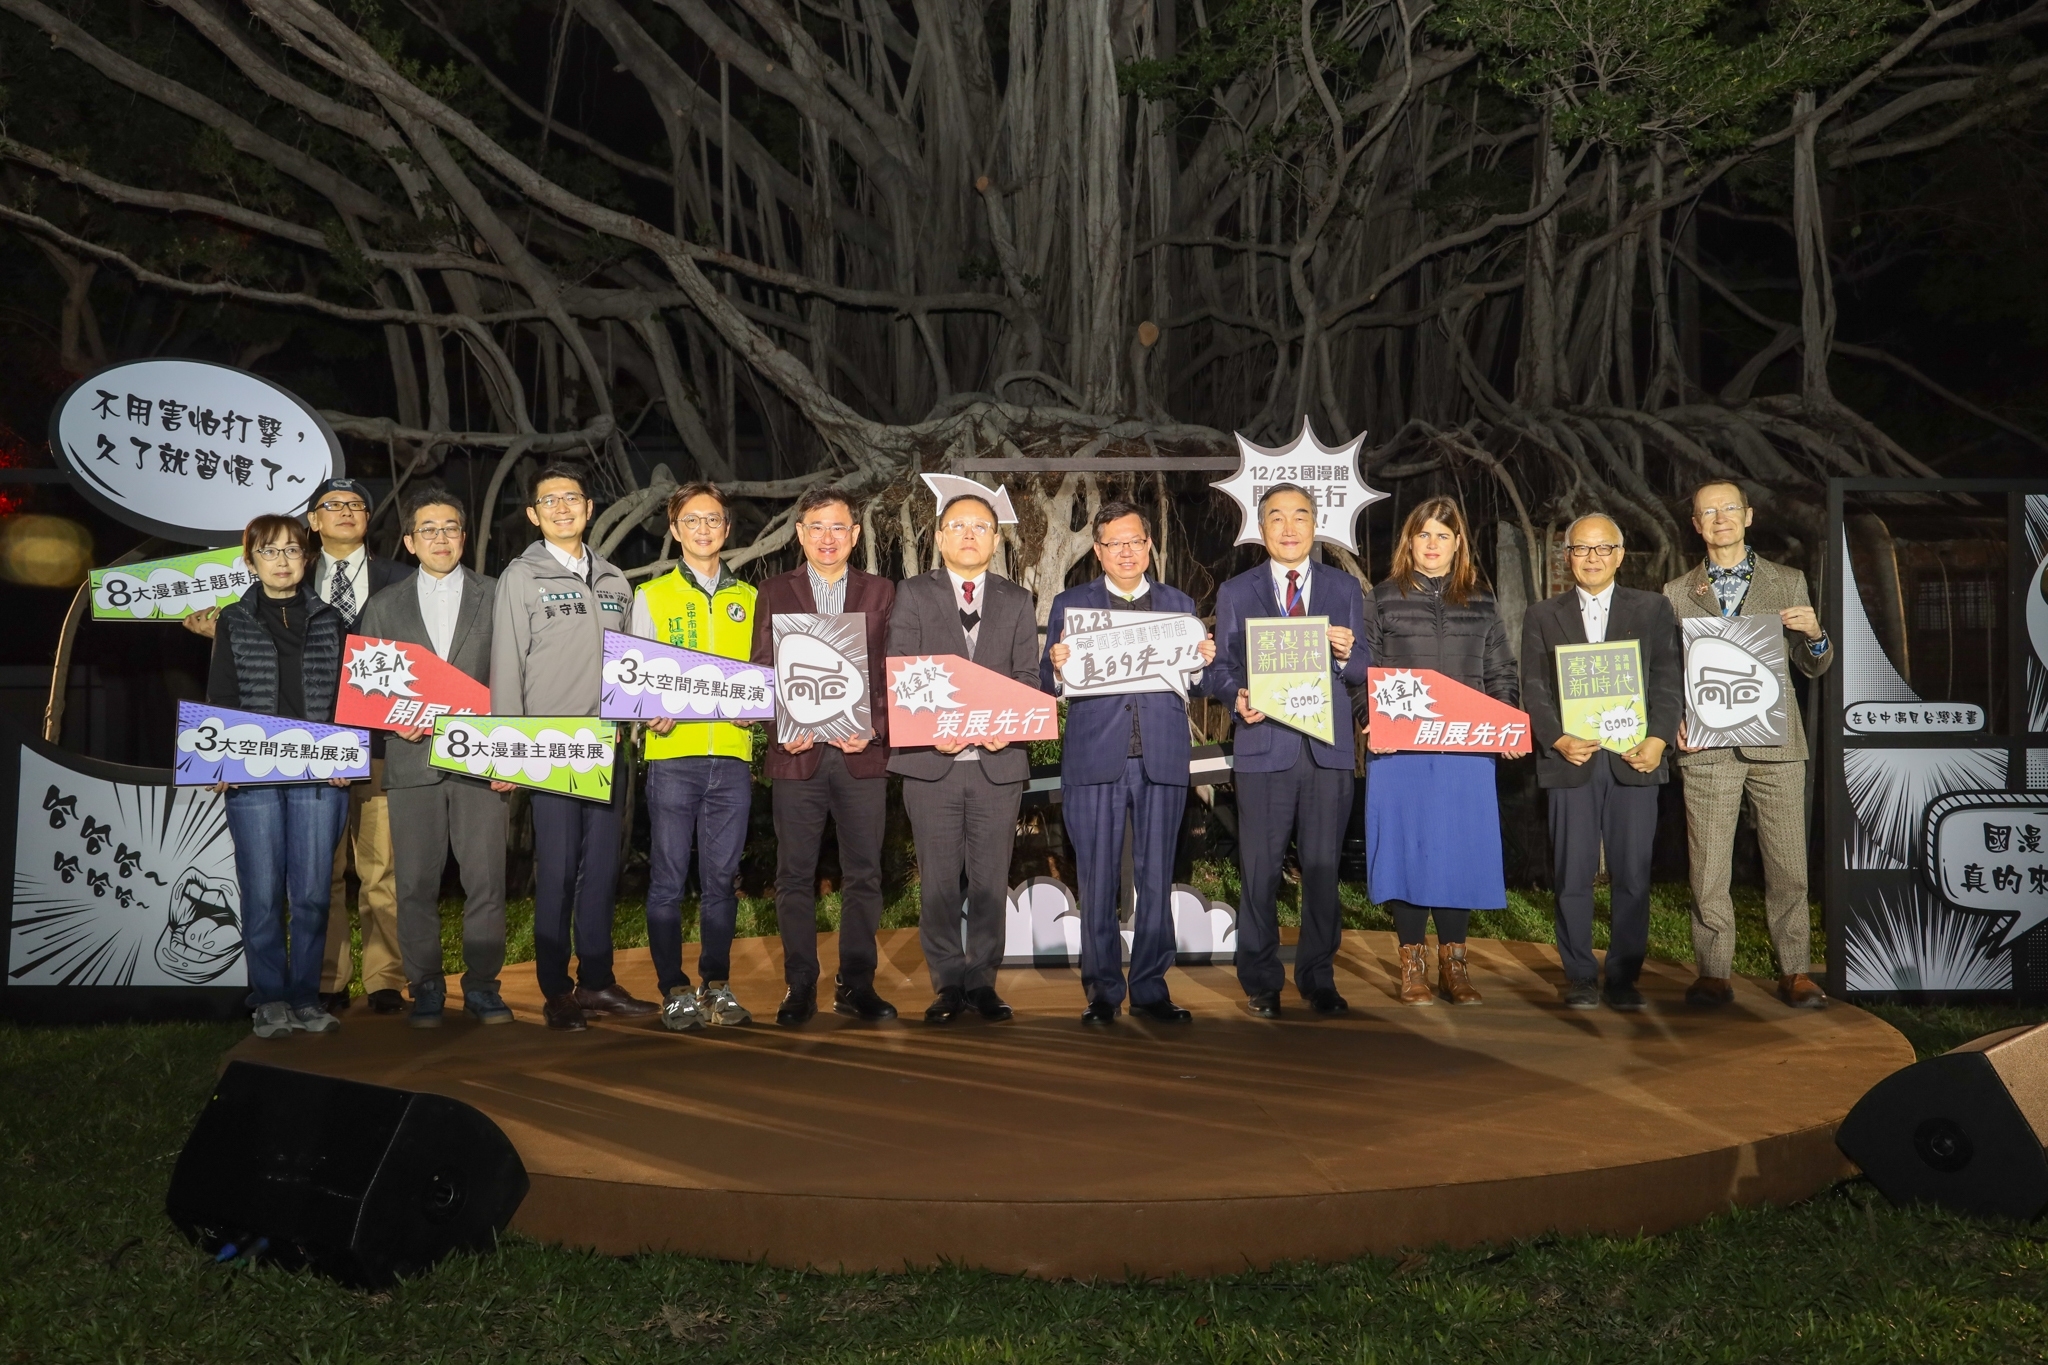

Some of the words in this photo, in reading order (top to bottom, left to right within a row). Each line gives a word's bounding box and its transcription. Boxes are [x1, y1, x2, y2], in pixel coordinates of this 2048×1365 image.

[686, 602, 697, 648] 台中市議員
[1067, 610, 1112, 634] 12.23
[1096, 620, 1187, 650] 國家漫畫博物館
[1258, 650, 1322, 672] 新時代
[618, 657, 765, 702] 3大空間亮點展演
[1569, 674, 1635, 697] 新時代
[384, 699, 491, 728] 開展
[1290, 695, 1319, 708] GOOD
[933, 707, 1050, 739] 策展先行
[1604, 717, 1634, 731] GOOD
[1852, 710, 1978, 725] 在台中遇見台灣漫畫
[195, 726, 359, 762] 3大空間亮點展演
[447, 729, 605, 759] 8大漫畫主題策展
[1413, 721, 1526, 747] 開展先行
